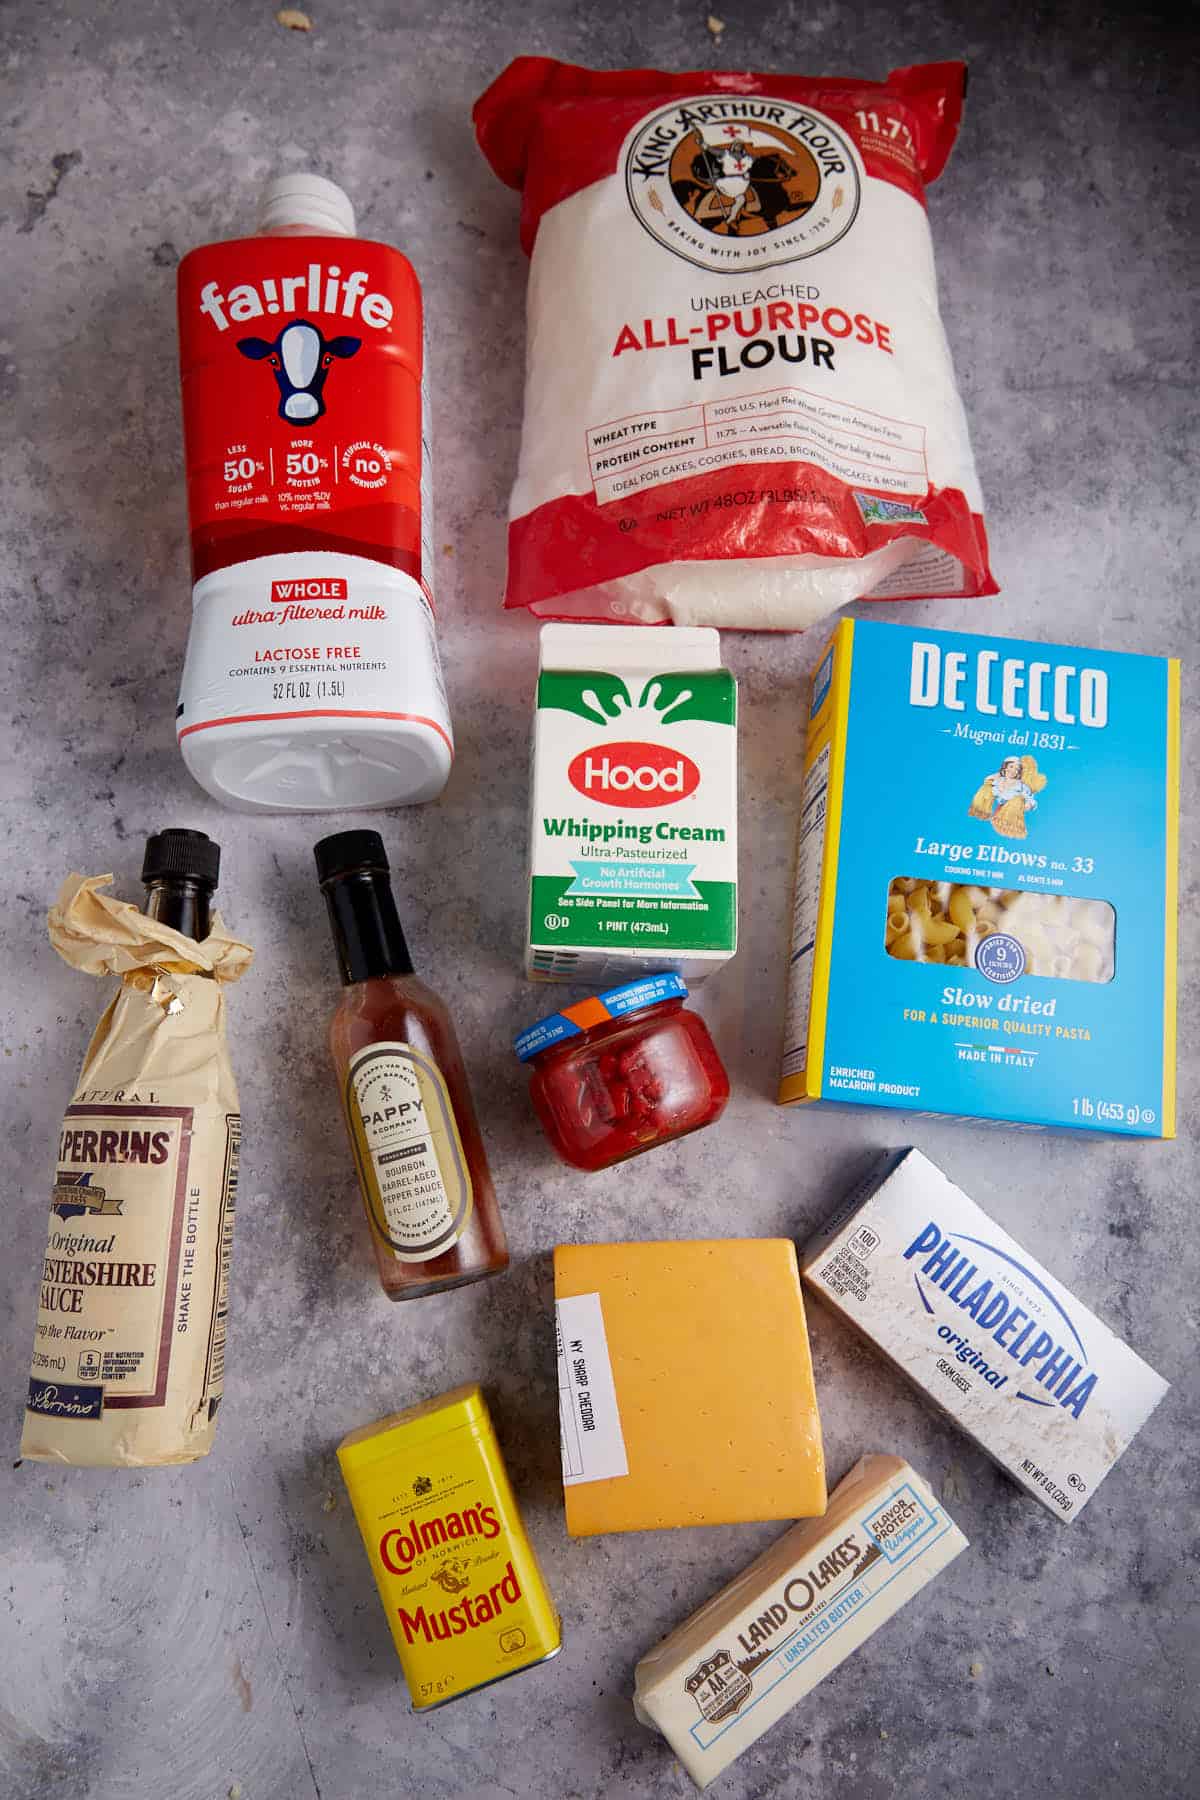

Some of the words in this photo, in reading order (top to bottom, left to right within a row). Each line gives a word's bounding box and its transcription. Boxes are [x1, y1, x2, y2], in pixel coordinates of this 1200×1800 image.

[632, 126, 677, 182] KING
[675, 103, 785, 132] ARTHUR
[787, 116, 845, 178] FLOUR
[668, 221, 704, 249] BAKING
[710, 247, 741, 258] WITH
[748, 247, 767, 257] JOY
[774, 232, 805, 249] SINCE
[691, 285, 820, 312] UNBLEACHED
[612, 301, 894, 357] ALL-PURPOSE
[691, 335, 835, 380] FLOUR
[714, 405, 738, 417] 100%
[759, 398, 779, 410] Hard
[593, 428, 628, 446] WHEAT
[630, 421, 657, 434] TYPE
[757, 420, 792, 433] versatile
[227, 444, 247, 455] LESS
[290, 439, 314, 449] MORE
[596, 449, 640, 471] PROTEIN
[642, 437, 697, 454] CONTENT
[223, 457, 264, 482] 50%
[286, 452, 329, 475] 50%
[355, 458, 381, 475] no
[612, 479, 639, 492] IDEAL
[641, 468, 660, 482] FOR
[662, 461, 697, 476] CAKES,
[698, 449, 747, 466] COOKIES,
[750, 446, 787, 457] BREAD,
[227, 482, 253, 494] SUGAR
[286, 477, 321, 488] PROTEIN
[349, 473, 388, 489] HORMONES
[214, 499, 230, 511] than
[231, 496, 254, 509] regular
[255, 493, 269, 504] milk
[278, 492, 292, 502] 10%
[291, 502, 315, 512] regular
[316, 502, 331, 510] milk
[656, 507, 687, 521] NET
[690, 501, 710, 516] WT
[275, 582, 340, 599] WHOLE
[231, 604, 345, 626] ultra-filtered
[348, 605, 387, 620] milk
[255, 647, 320, 662] LACTOSE
[326, 646, 361, 659] FREE
[229, 666, 276, 677] CONTAINS
[279, 665, 286, 674] 9
[289, 664, 337, 673] ESSENTIAL
[340, 662, 387, 672] NUTRIENTS
[273, 683, 284, 699] 52
[286, 682, 296, 698] FL
[299, 681, 310, 698] OZ
[317, 680, 345, 699] (1.5L)
[976, 650, 1108, 729] CECCO
[953, 722, 1005, 745] Mugnai
[1008, 729, 1029, 746] dal
[1032, 732, 1066, 751] 1831
[584, 757, 684, 792] Hood
[543, 818, 653, 844] Whipping
[656, 822, 726, 842] Cream
[581, 845, 688, 860] Ultra-Pasteurized
[915, 837, 973, 862] Large
[976, 844, 1047, 868] Elbows
[1051, 861, 1068, 871] no.
[1071, 856, 1094, 874] 33
[600, 866, 616, 876] No
[617, 866, 665, 878] Artificial
[582, 878, 622, 890] Growth
[624, 880, 680, 891] Hormones
[558, 897, 574, 906] See
[576, 897, 594, 907] Side
[596, 898, 620, 908] Panel
[622, 898, 635, 908] for
[636, 899, 658, 909] More
[660, 900, 709, 911] Information
[606, 921, 628, 932] PINT
[630, 921, 669, 935] (473mL)
[996, 947, 1007, 961] 9
[941, 987, 993, 1009] Slow
[998, 992, 1056, 1017] dried
[903, 1008, 926, 1022] FOR
[930, 1014, 938, 1024] A
[942, 1013, 999, 1030] SUPERIOR
[1003, 1020, 1051, 1038] QUALITY
[1055, 1027, 1092, 1041] PASTA
[958, 1050, 987, 1062] MADE
[990, 1053, 1002, 1064] IN
[1004, 1054, 1035, 1068] ITALY
[830, 1066, 875, 1080] ENRICHED
[829, 1078, 876, 1092] MACARONI
[878, 1082, 920, 1097] PRODUCT
[361, 1099, 424, 1128] PAPPY
[1072, 1099, 1079, 1114] 1
[1081, 1099, 1094, 1116] lb
[378, 1118, 417, 1134] COMPANY
[63, 1130, 170, 1164] PERRINS
[385, 1160, 425, 1178] BOURBON
[382, 1170, 437, 1192] BARREL-AGED
[382, 1190, 413, 1204] PEPPER
[414, 1182, 442, 1197] SAUCE
[186, 1188, 200, 1244] BOTTLE
[398, 1220, 410, 1228] THE
[412, 1218, 429, 1228] HEAT
[52, 1231, 116, 1257] Original
[859, 1230, 876, 1247] 100
[184, 1249, 194, 1277] THE
[178, 1282, 191, 1332] SHAKE
[903, 1222, 1098, 1419] PHILADELPHIA
[48, 1324, 62, 1338] the
[64, 1326, 106, 1341] Flavor
[570, 1339, 584, 1353] NY
[87, 1354, 93, 1365] 5
[937, 1325, 1009, 1390] original
[573, 1358, 588, 1387] SHARP
[936, 1358, 954, 1378] CREAM
[952, 1372, 973, 1394] CHEESE
[578, 1391, 596, 1432] CHEDDAR
[1021, 1459, 1035, 1473] NET
[1032, 1469, 1044, 1482] WT
[1045, 1482, 1056, 1494] OZ
[872, 1499, 908, 1532] FLAVOR
[875, 1502, 916, 1541] PROTECT
[379, 1502, 500, 1575] Colman's
[416, 1558, 427, 1566] OF
[432, 1537, 480, 1560] NORWICH
[398, 1561, 521, 1645] Mustard
[737, 1603, 788, 1654] LAND
[808, 1538, 861, 1591] LAKES
[785, 1619, 830, 1663] UNSALTED
[829, 1589, 864, 1624] BUTTER
[691, 1657, 727, 1689] USDA
[708, 1673, 727, 1695] AA
[420, 1682, 433, 1697] 57
